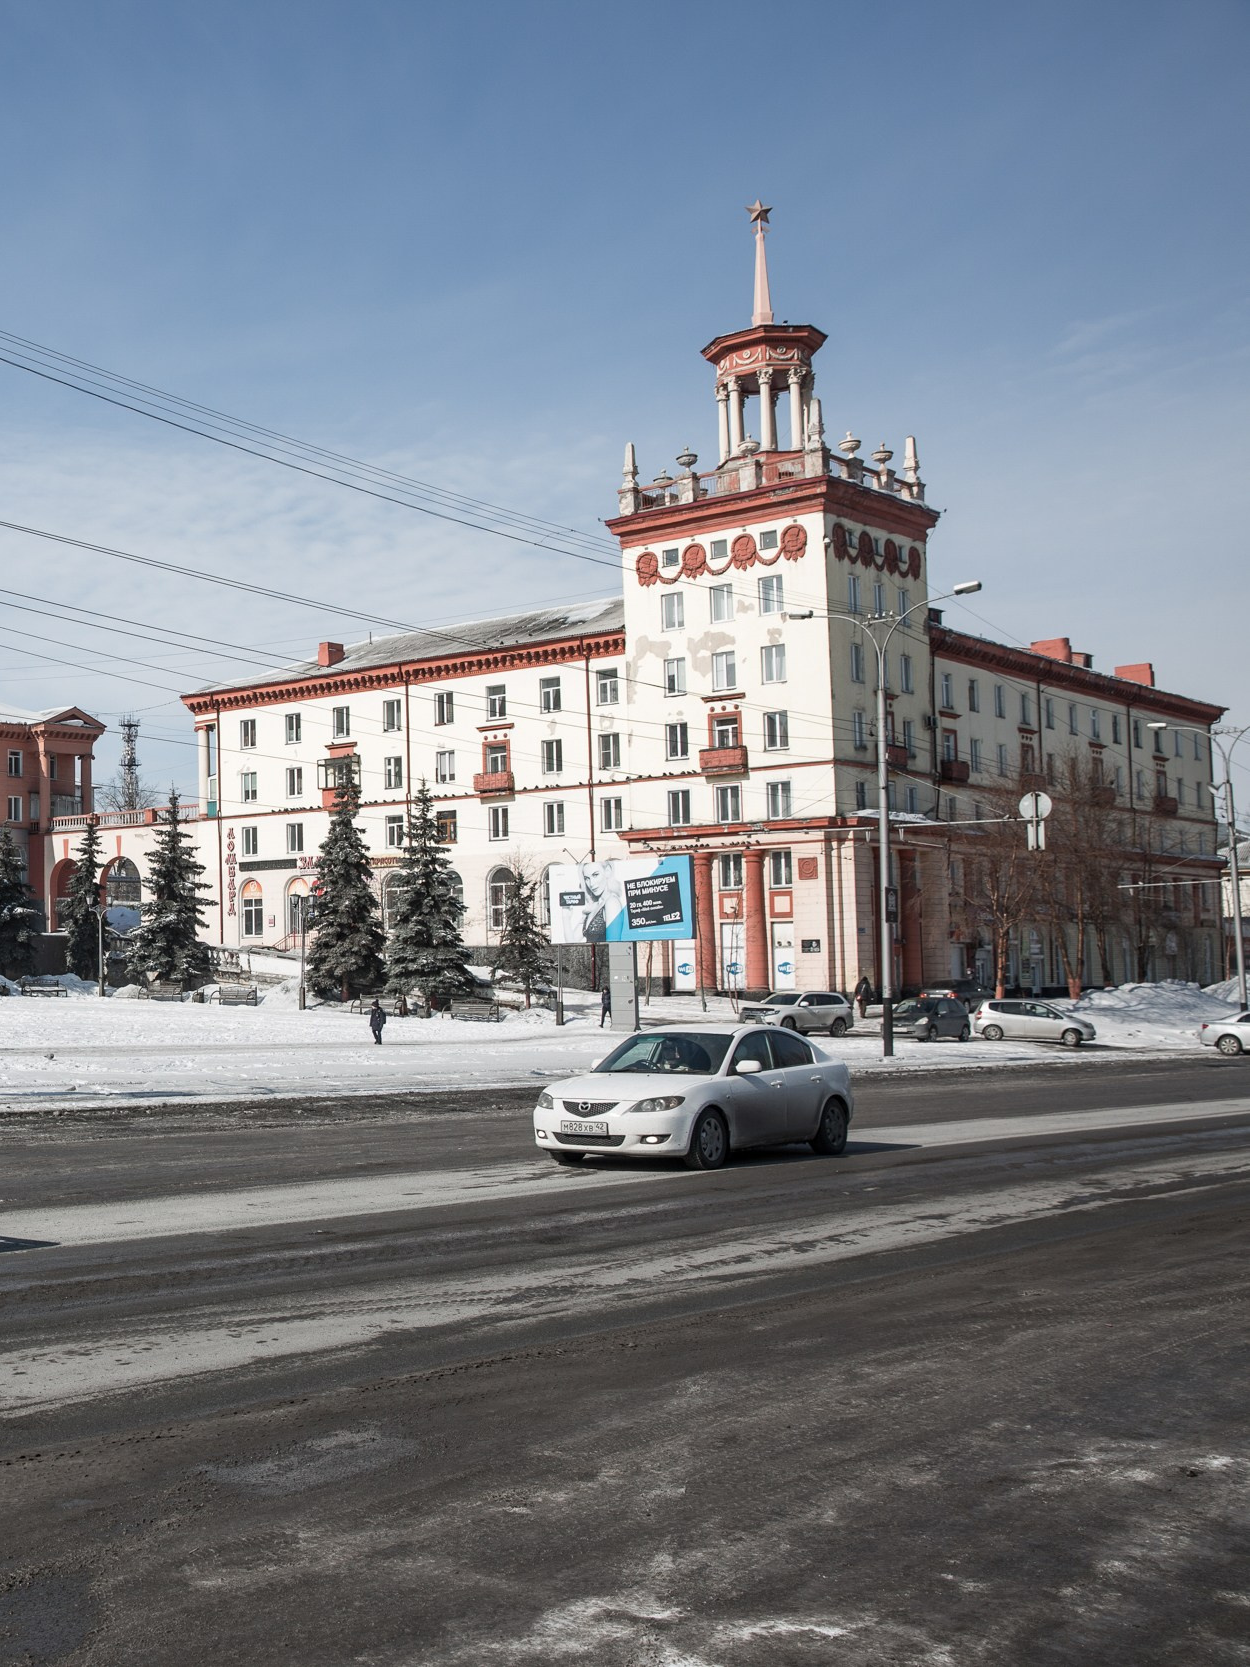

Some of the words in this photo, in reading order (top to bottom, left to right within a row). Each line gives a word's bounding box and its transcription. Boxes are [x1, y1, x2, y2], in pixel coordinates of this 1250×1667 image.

[225, 827, 237, 917] ЛОМБАРД
[636, 876, 676, 886] БЛОКИРУЕМ
[642, 884, 668, 894] МИНУСЕ
[632, 917, 646, 926] 350
[662, 912, 681, 922] TELE2
